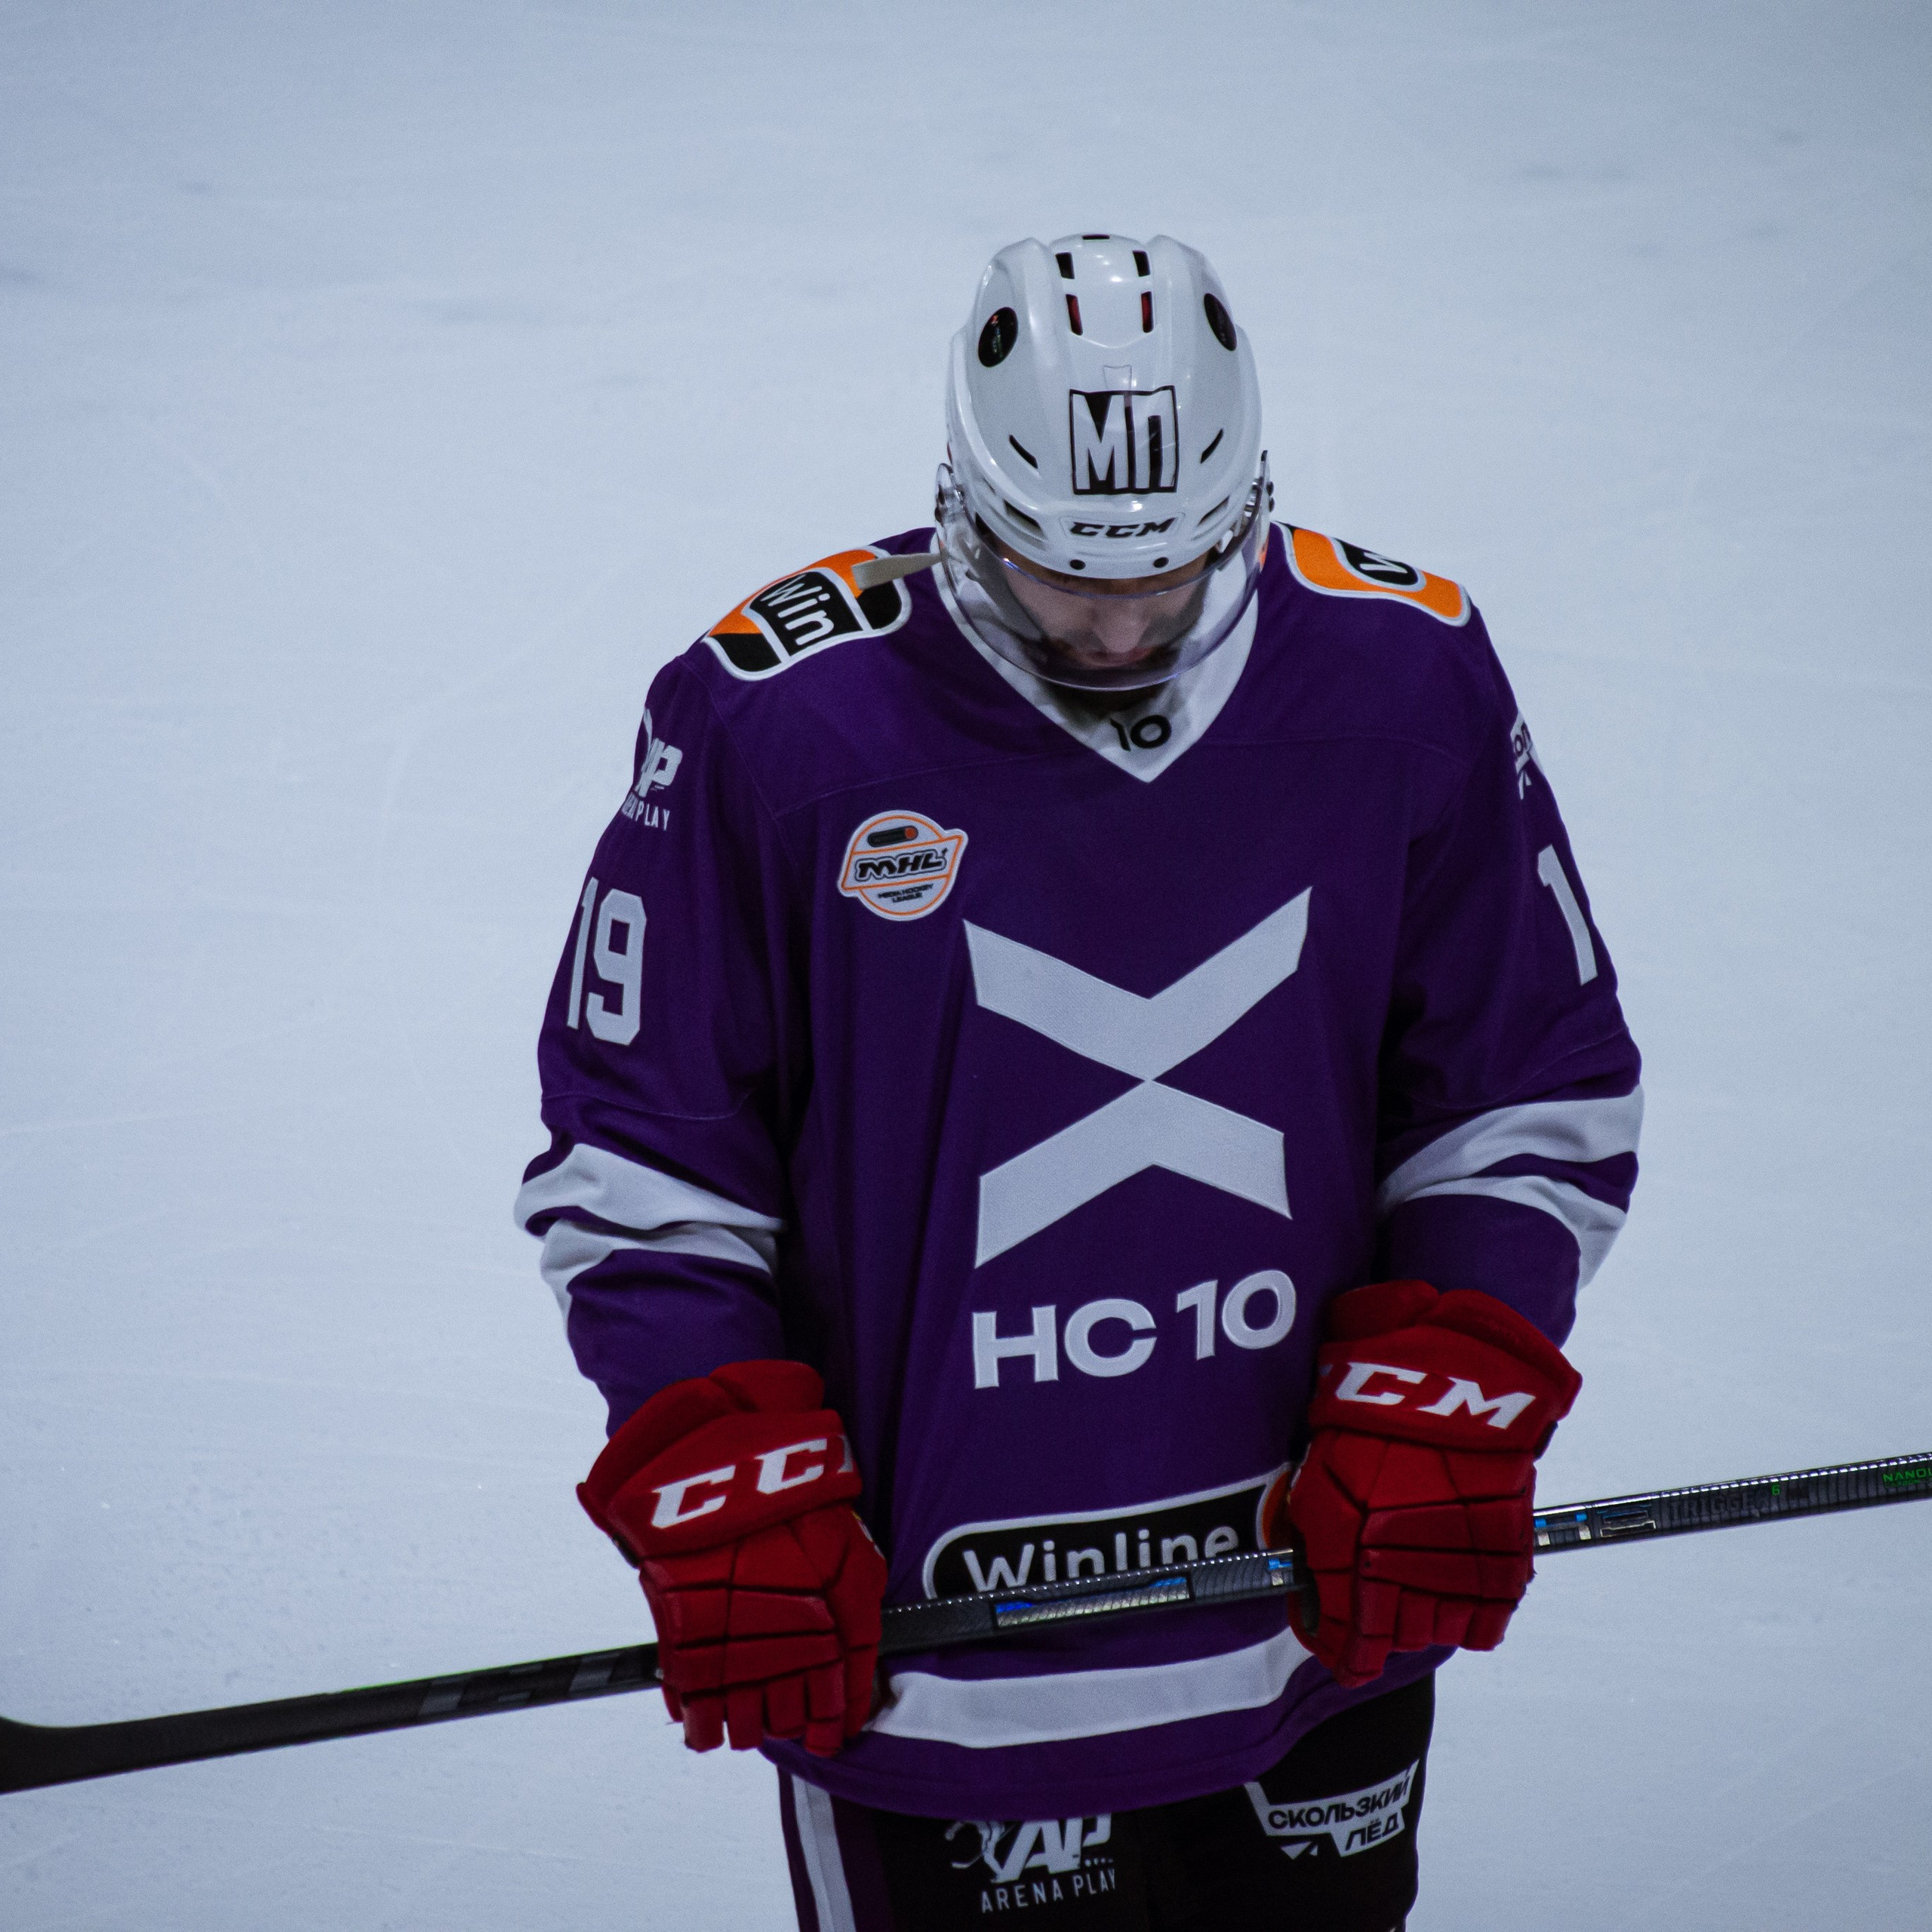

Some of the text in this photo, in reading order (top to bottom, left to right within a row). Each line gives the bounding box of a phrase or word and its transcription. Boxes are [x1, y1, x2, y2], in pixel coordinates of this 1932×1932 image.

[1069, 517, 1176, 539] CCM
[858, 853, 943, 878] MHL
[1537, 844, 1598, 986] 1
[567, 876, 647, 1046] 19
[972, 1269, 1297, 1389] HC 10
[1321, 1361, 1537, 1429] CM
[963, 1526, 1240, 1592] Winline
[1345, 1812, 1399, 1851] ЛЁД
[981, 1868, 1115, 1913] ARENA PLAY
